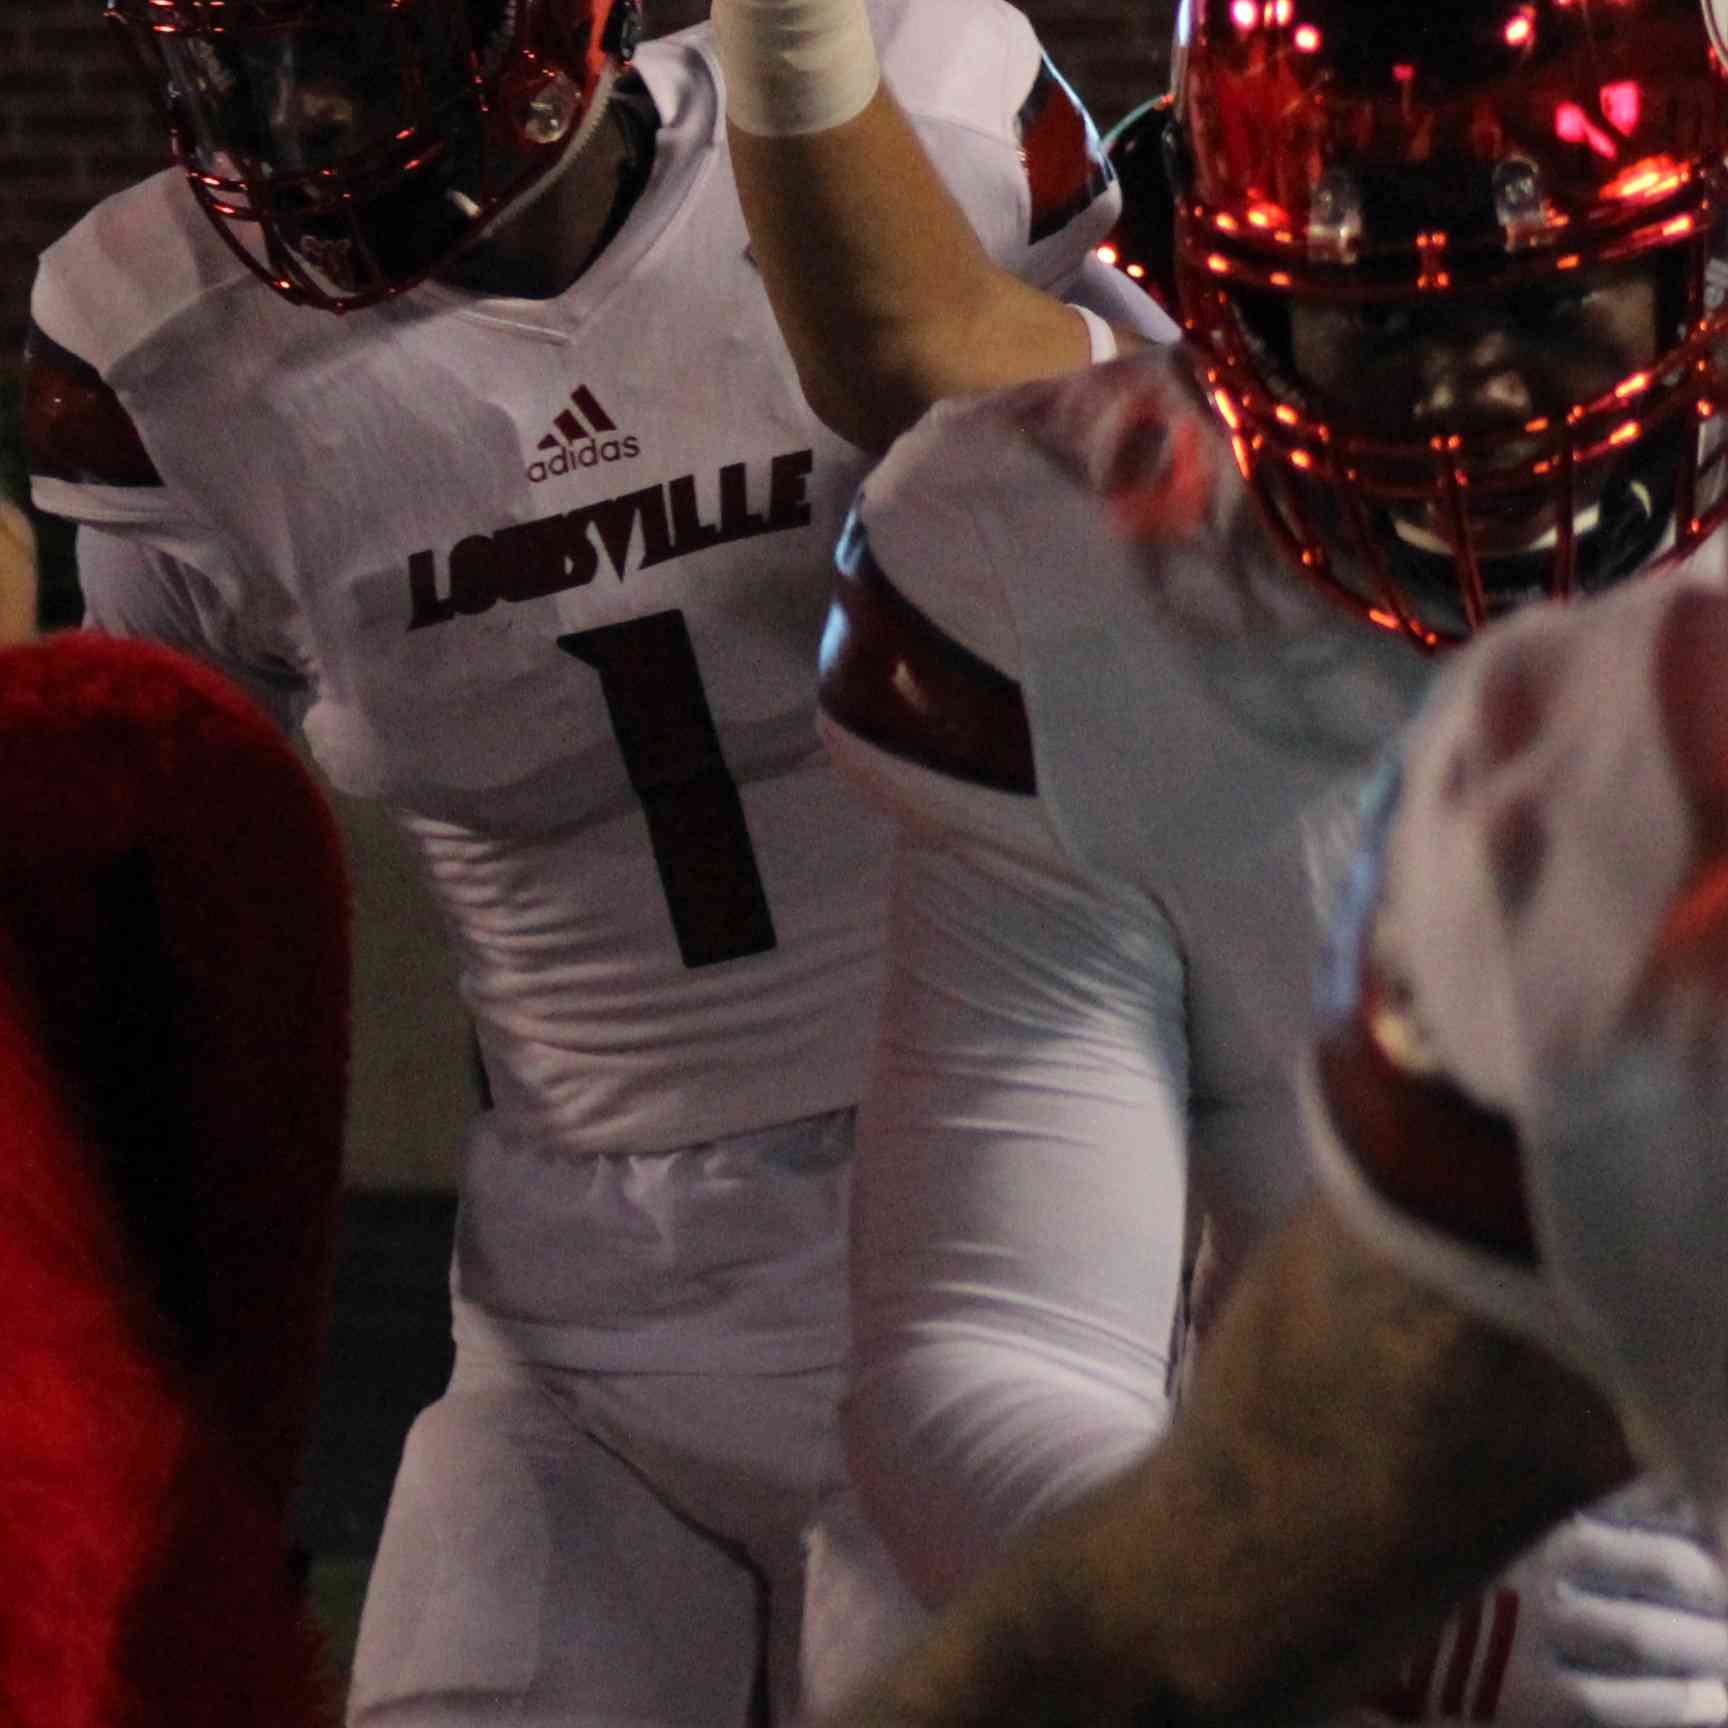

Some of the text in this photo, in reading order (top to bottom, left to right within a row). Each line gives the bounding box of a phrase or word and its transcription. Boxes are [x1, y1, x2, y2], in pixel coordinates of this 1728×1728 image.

[406, 449, 813, 632] LOUISVILLE
[526, 433, 641, 484] adidas
[556, 608, 777, 969] 1
